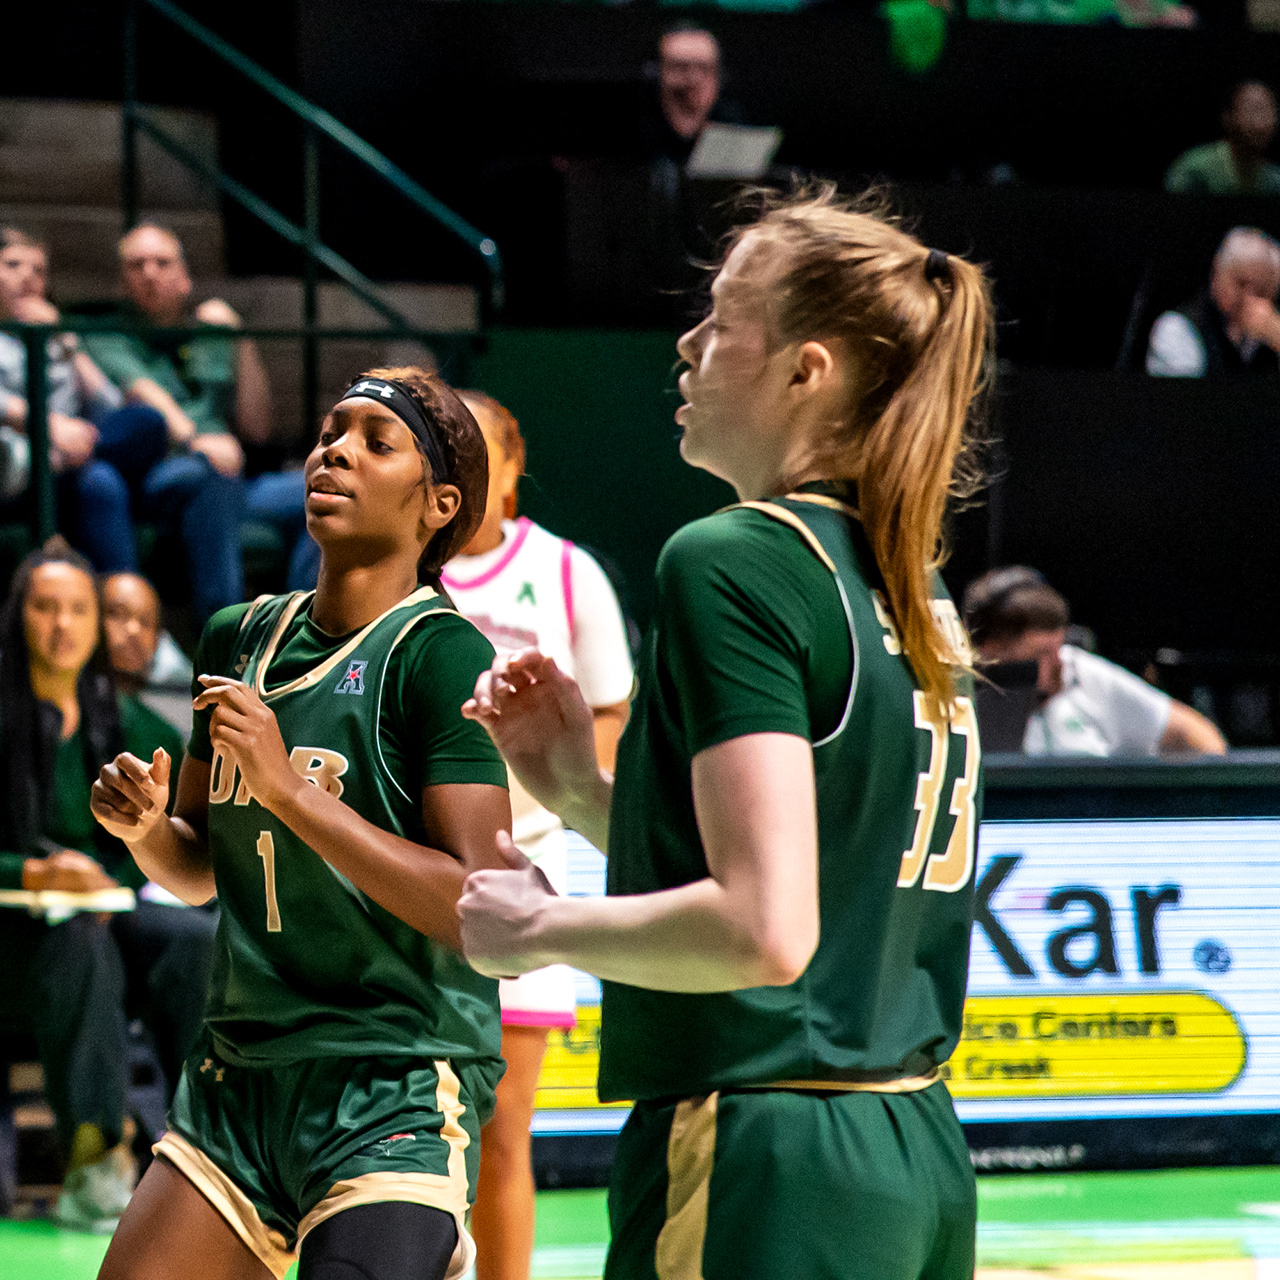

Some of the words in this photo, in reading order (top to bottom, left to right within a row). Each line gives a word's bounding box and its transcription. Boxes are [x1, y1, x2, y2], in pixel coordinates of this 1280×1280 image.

[209, 745, 350, 807] UB
[896, 689, 981, 893] 33
[256, 830, 282, 933] 1
